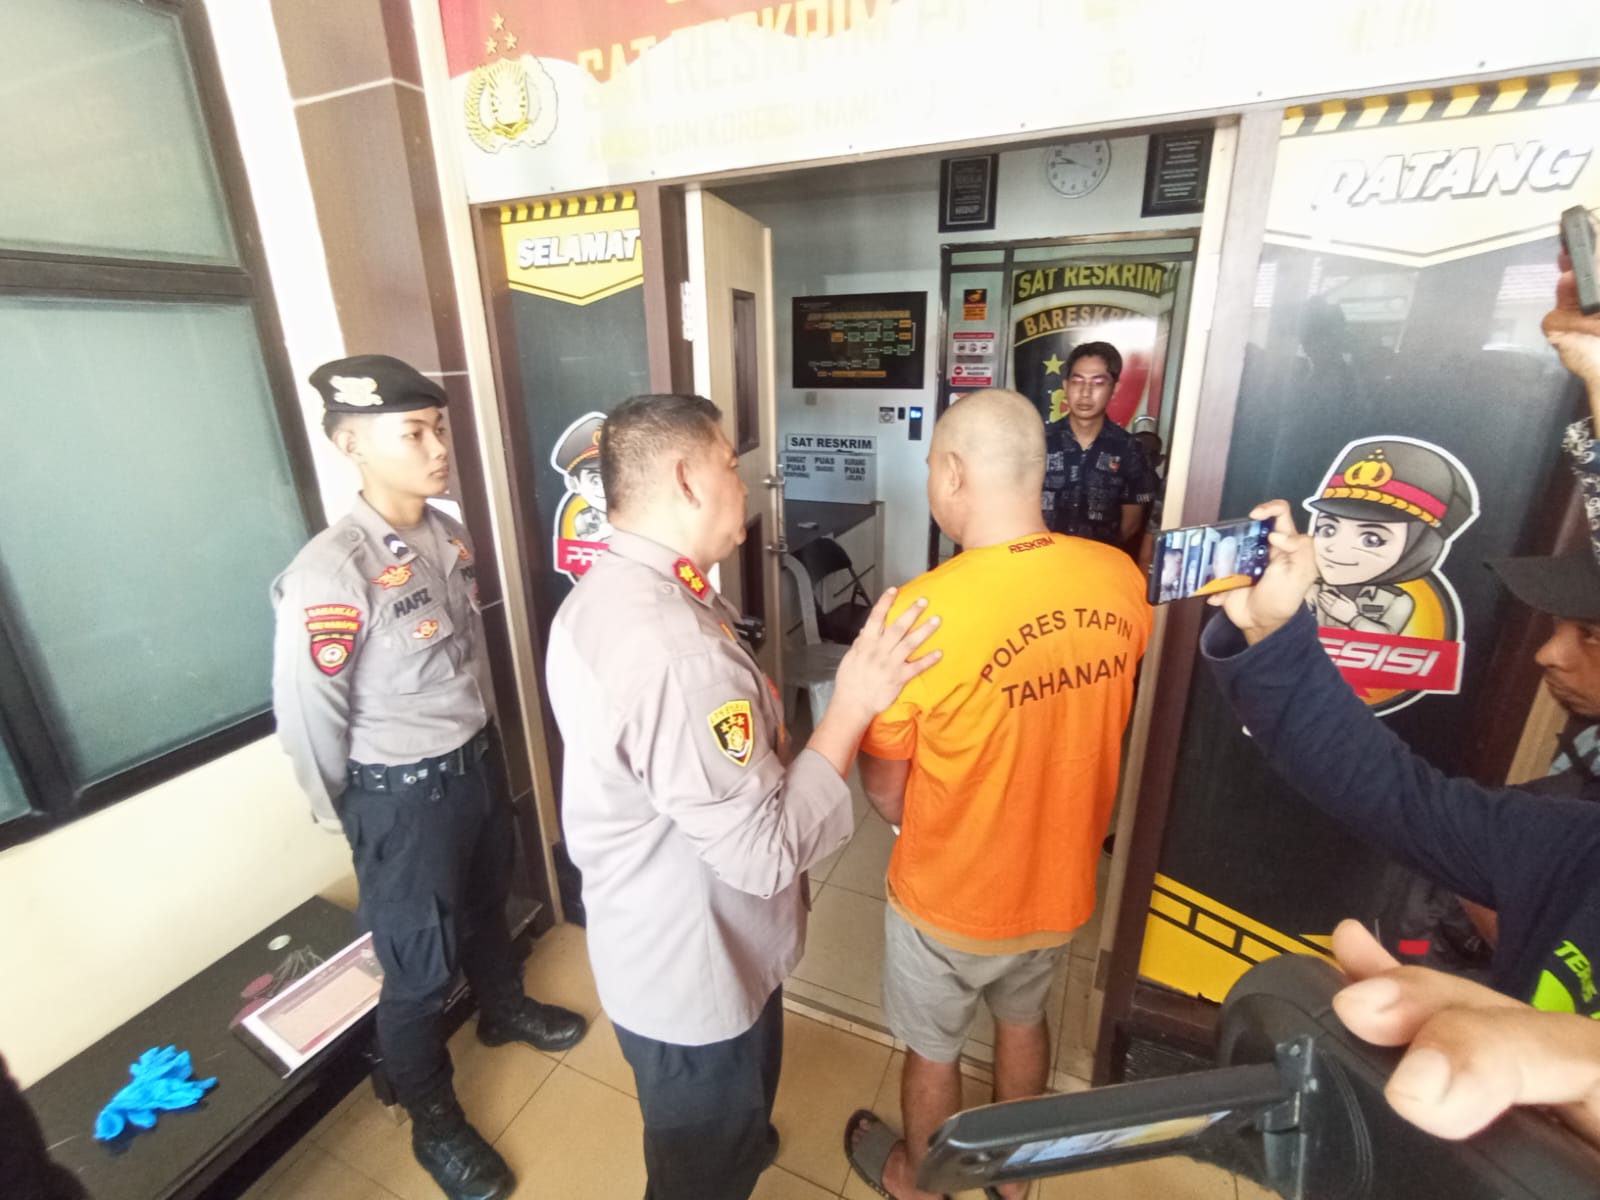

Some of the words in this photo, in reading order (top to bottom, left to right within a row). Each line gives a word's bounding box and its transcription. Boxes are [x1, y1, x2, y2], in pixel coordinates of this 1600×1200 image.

[1313, 140, 1593, 209] DATANG
[519, 228, 641, 270] SELAMAT
[1018, 268, 1059, 298] SAT
[1063, 263, 1164, 293] RESKRIM
[791, 437, 813, 447] SAT
[816, 438, 872, 449] RESKRIM
[786, 463, 806, 472] PUAS
[814, 457, 835, 465] PUAS
[844, 466, 866, 475] PUAS
[1008, 536, 1056, 554] RESKRIM
[393, 587, 433, 619] HAFIZ
[980, 610, 1067, 684] POLRES
[1074, 608, 1133, 641] TAPIN
[1318, 637, 1441, 677] ESISI
[1001, 652, 1128, 709] TAHANAN
